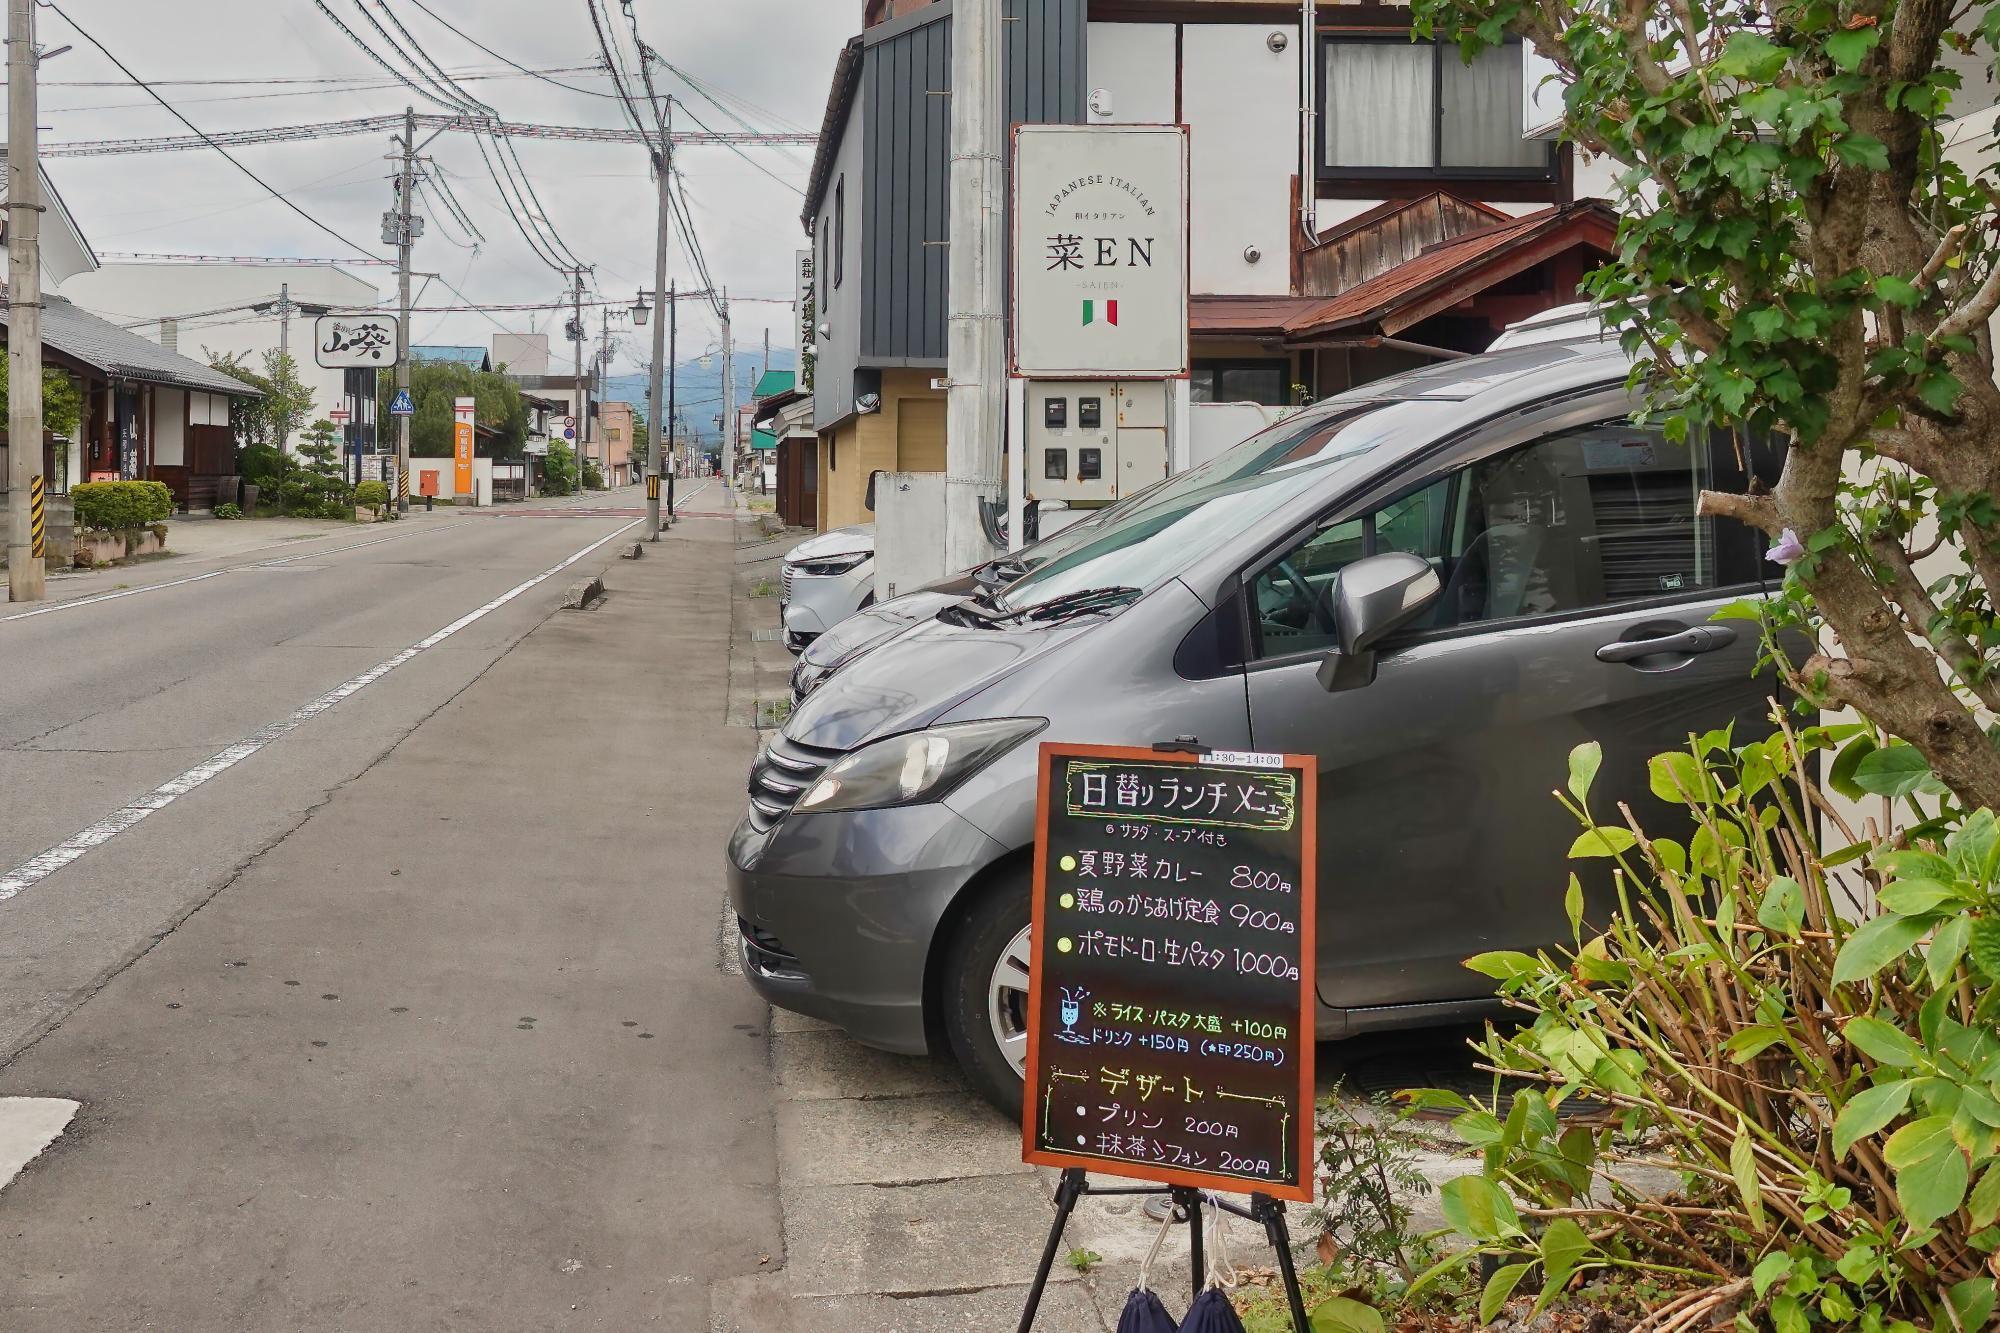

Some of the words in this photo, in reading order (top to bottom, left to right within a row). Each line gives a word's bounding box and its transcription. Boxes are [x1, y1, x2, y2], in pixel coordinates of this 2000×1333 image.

[1045, 174, 1103, 217] JAPANESE
[1109, 176, 1155, 217] ITALIAN
[1046, 233, 1155, 271] 菜EN
[1078, 850, 1203, 882] 夏野菜カレー
[1230, 865, 1292, 893] 800円
[1076, 888, 1221, 926] 鶏のからあげ定食
[1230, 903, 1295, 934] 900円
[1092, 1027, 1133, 1047] ドリンク
[1138, 1034, 1189, 1053] +150円
[1231, 1019, 1287, 1040] +100円
[1100, 1066, 1204, 1103] デザート
[1098, 1103, 1163, 1129] プリン
[1185, 1116, 1239, 1139] 200円
[1096, 1132, 1207, 1166] 抹茶シフォン
[1219, 1151, 1270, 1175] 200円
